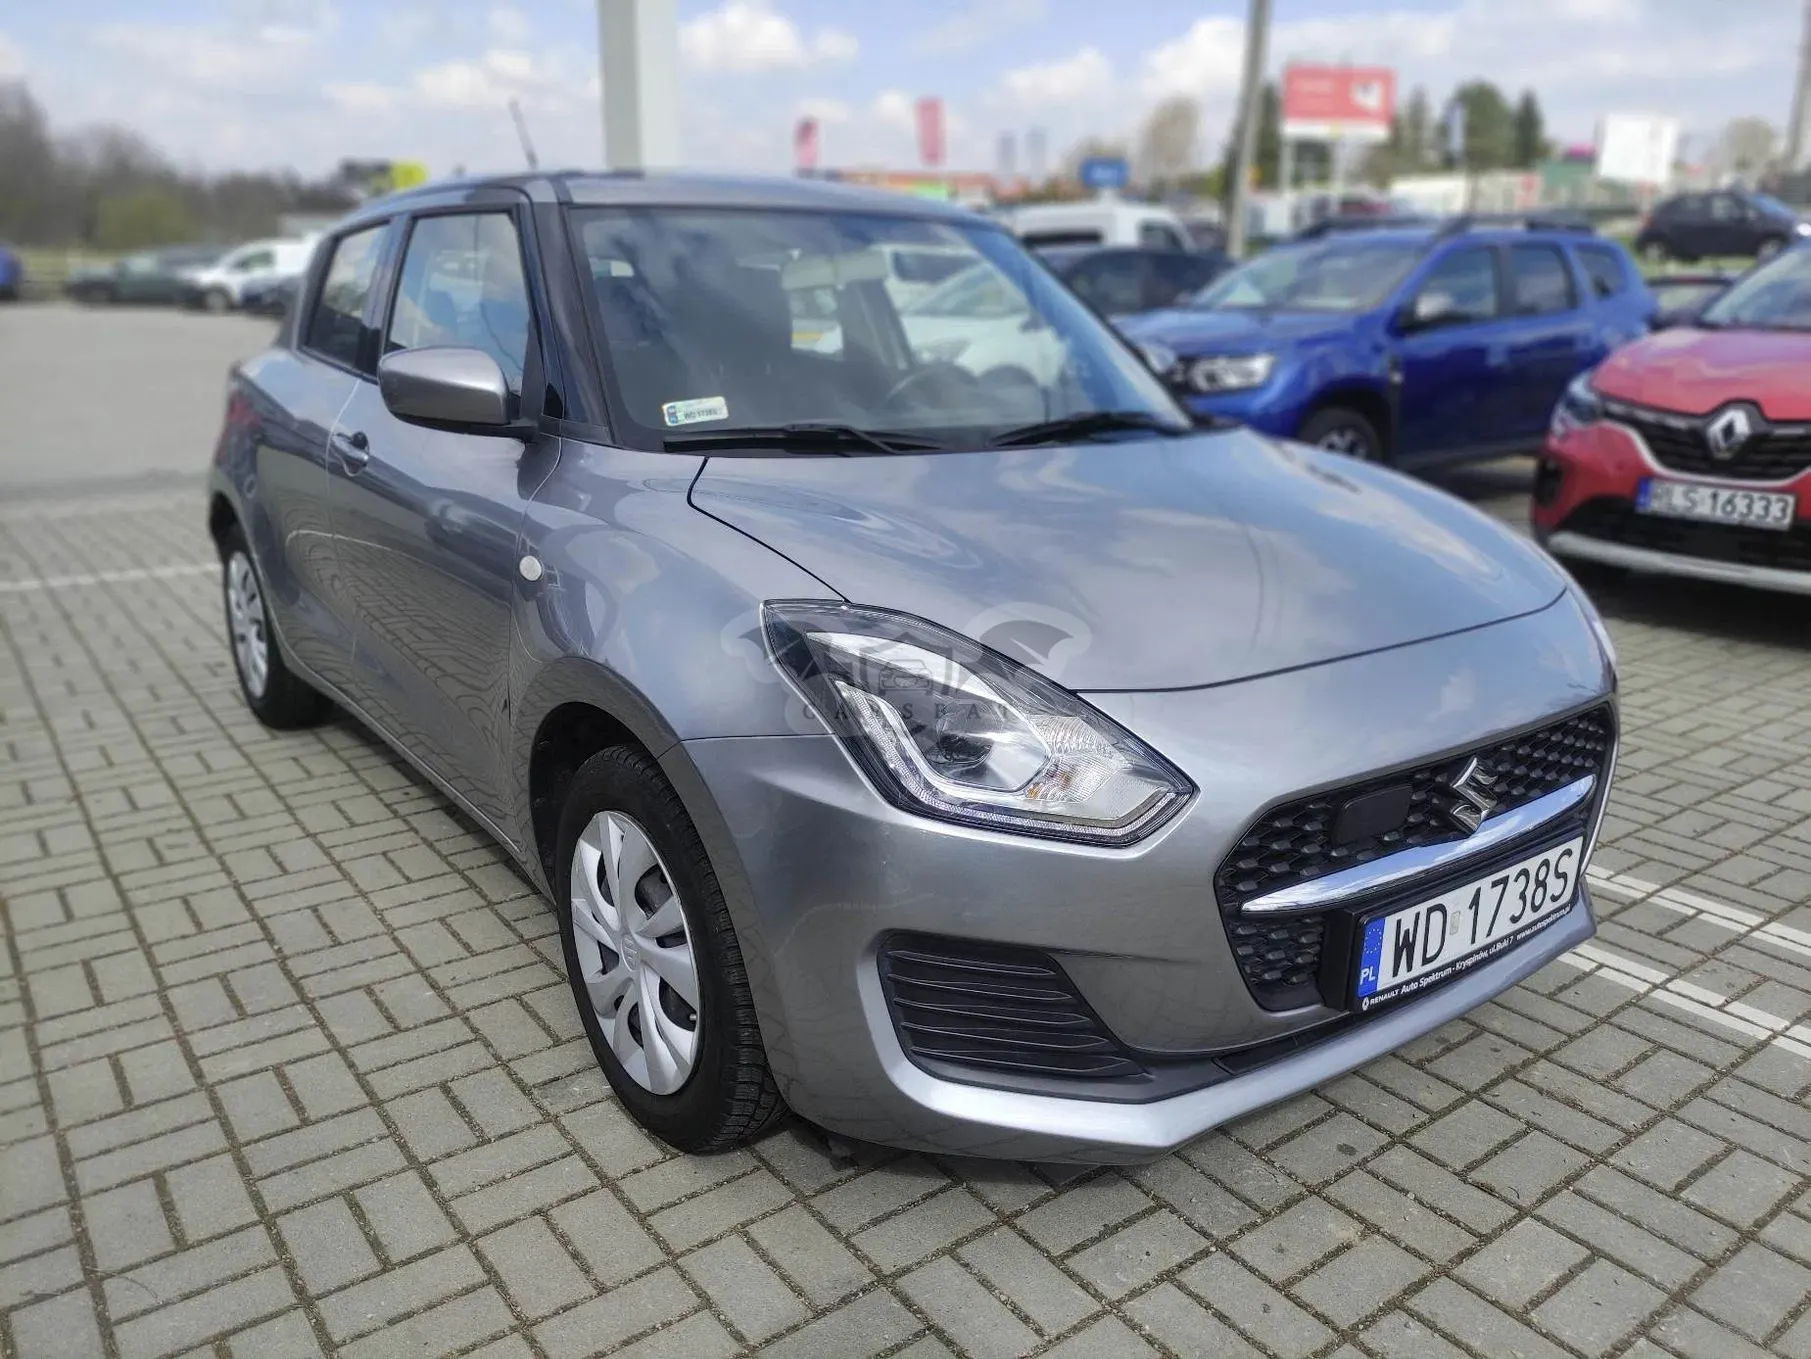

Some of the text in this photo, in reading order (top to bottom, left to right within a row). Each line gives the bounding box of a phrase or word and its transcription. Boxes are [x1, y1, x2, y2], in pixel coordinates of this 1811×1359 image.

[1710, 489, 1789, 522] 16333
[1392, 847, 1573, 978] WD 1738S
[1360, 966, 1376, 985] PL
[1369, 989, 1400, 1005] RENAULT
[1400, 981, 1418, 995] Auto
[1419, 965, 1452, 988] Spektrum
